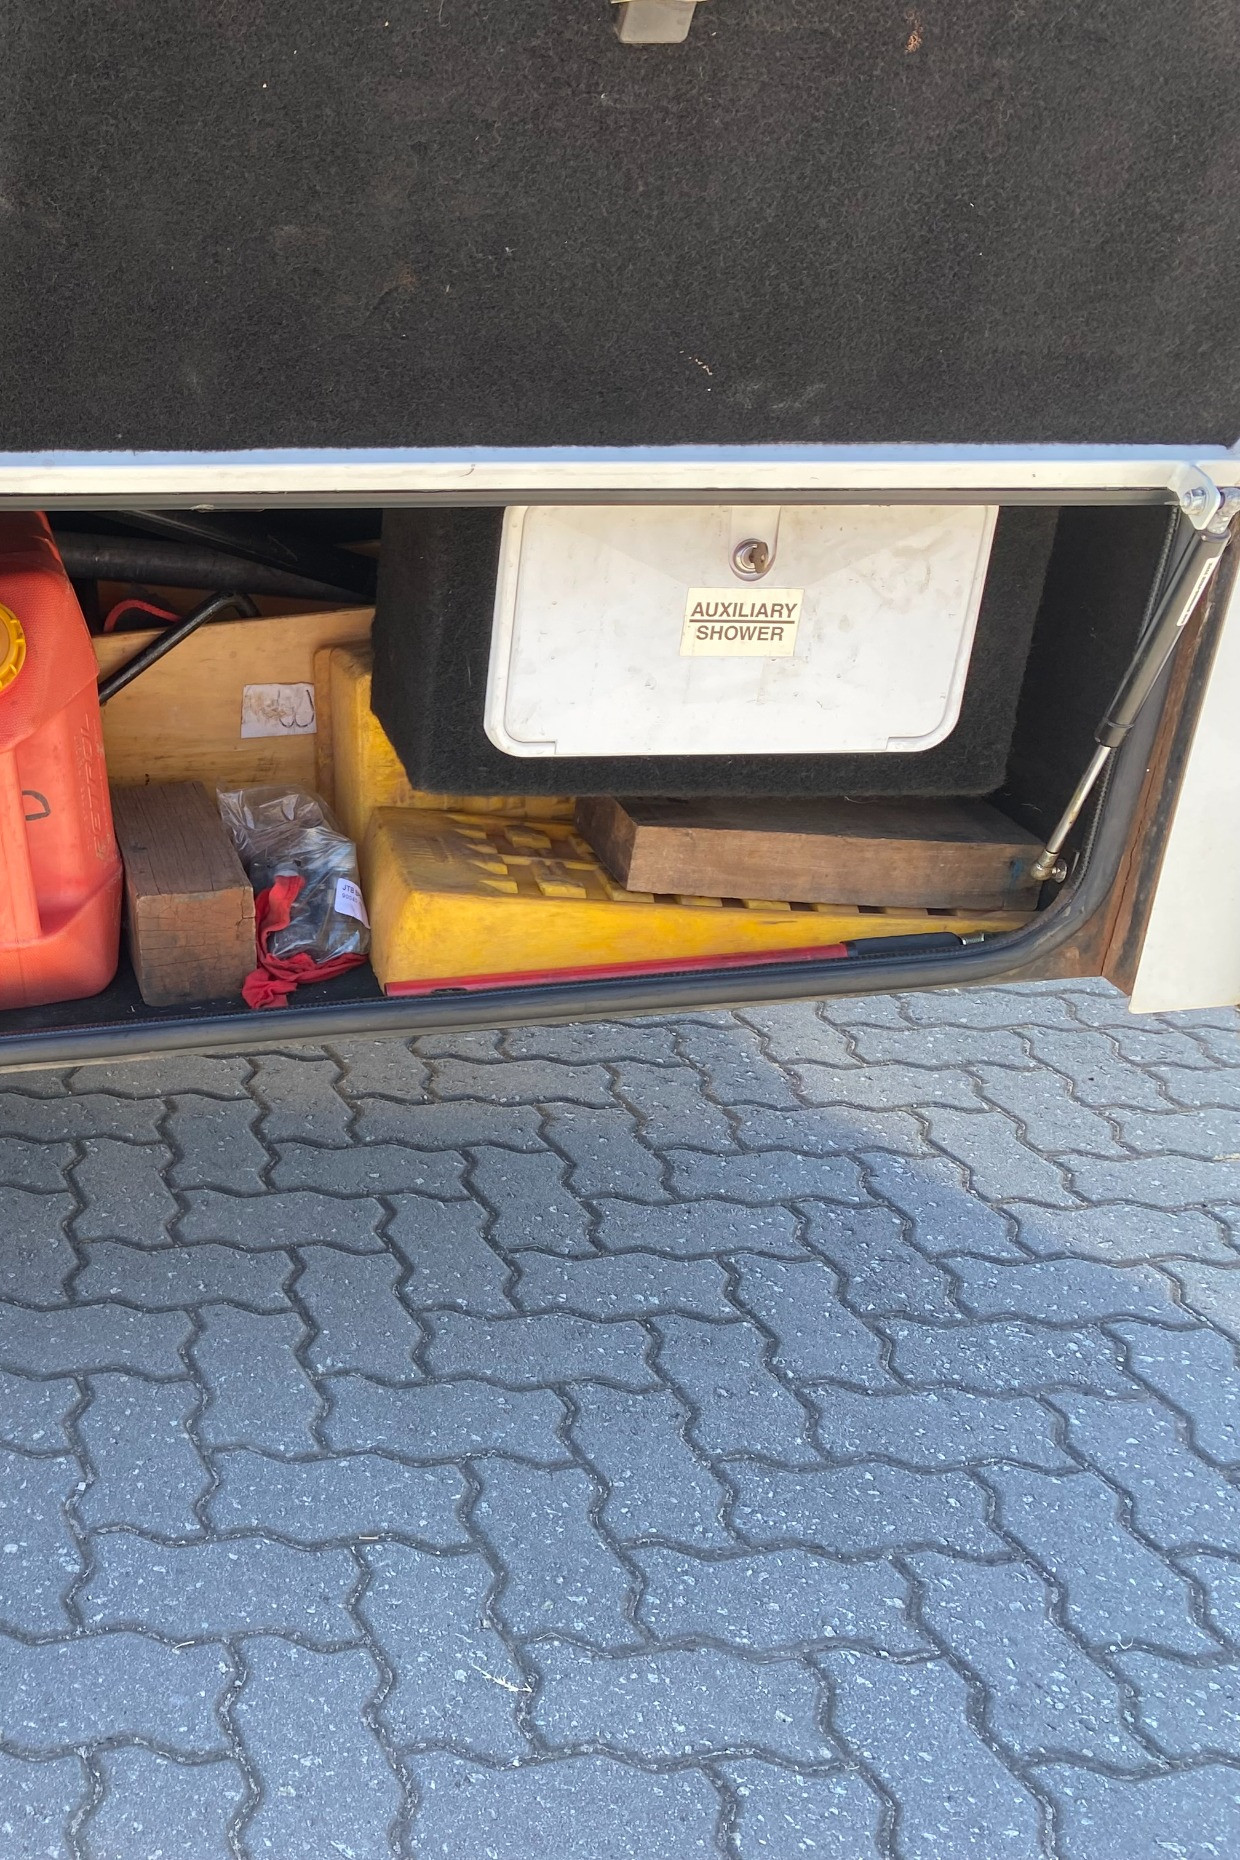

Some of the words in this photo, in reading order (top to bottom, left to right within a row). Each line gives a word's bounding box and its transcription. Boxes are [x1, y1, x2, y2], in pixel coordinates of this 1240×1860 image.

[690, 602, 798, 618] AUXILIARY
[696, 625, 784, 641] SHOWER
[342, 884, 354, 894] JTB
